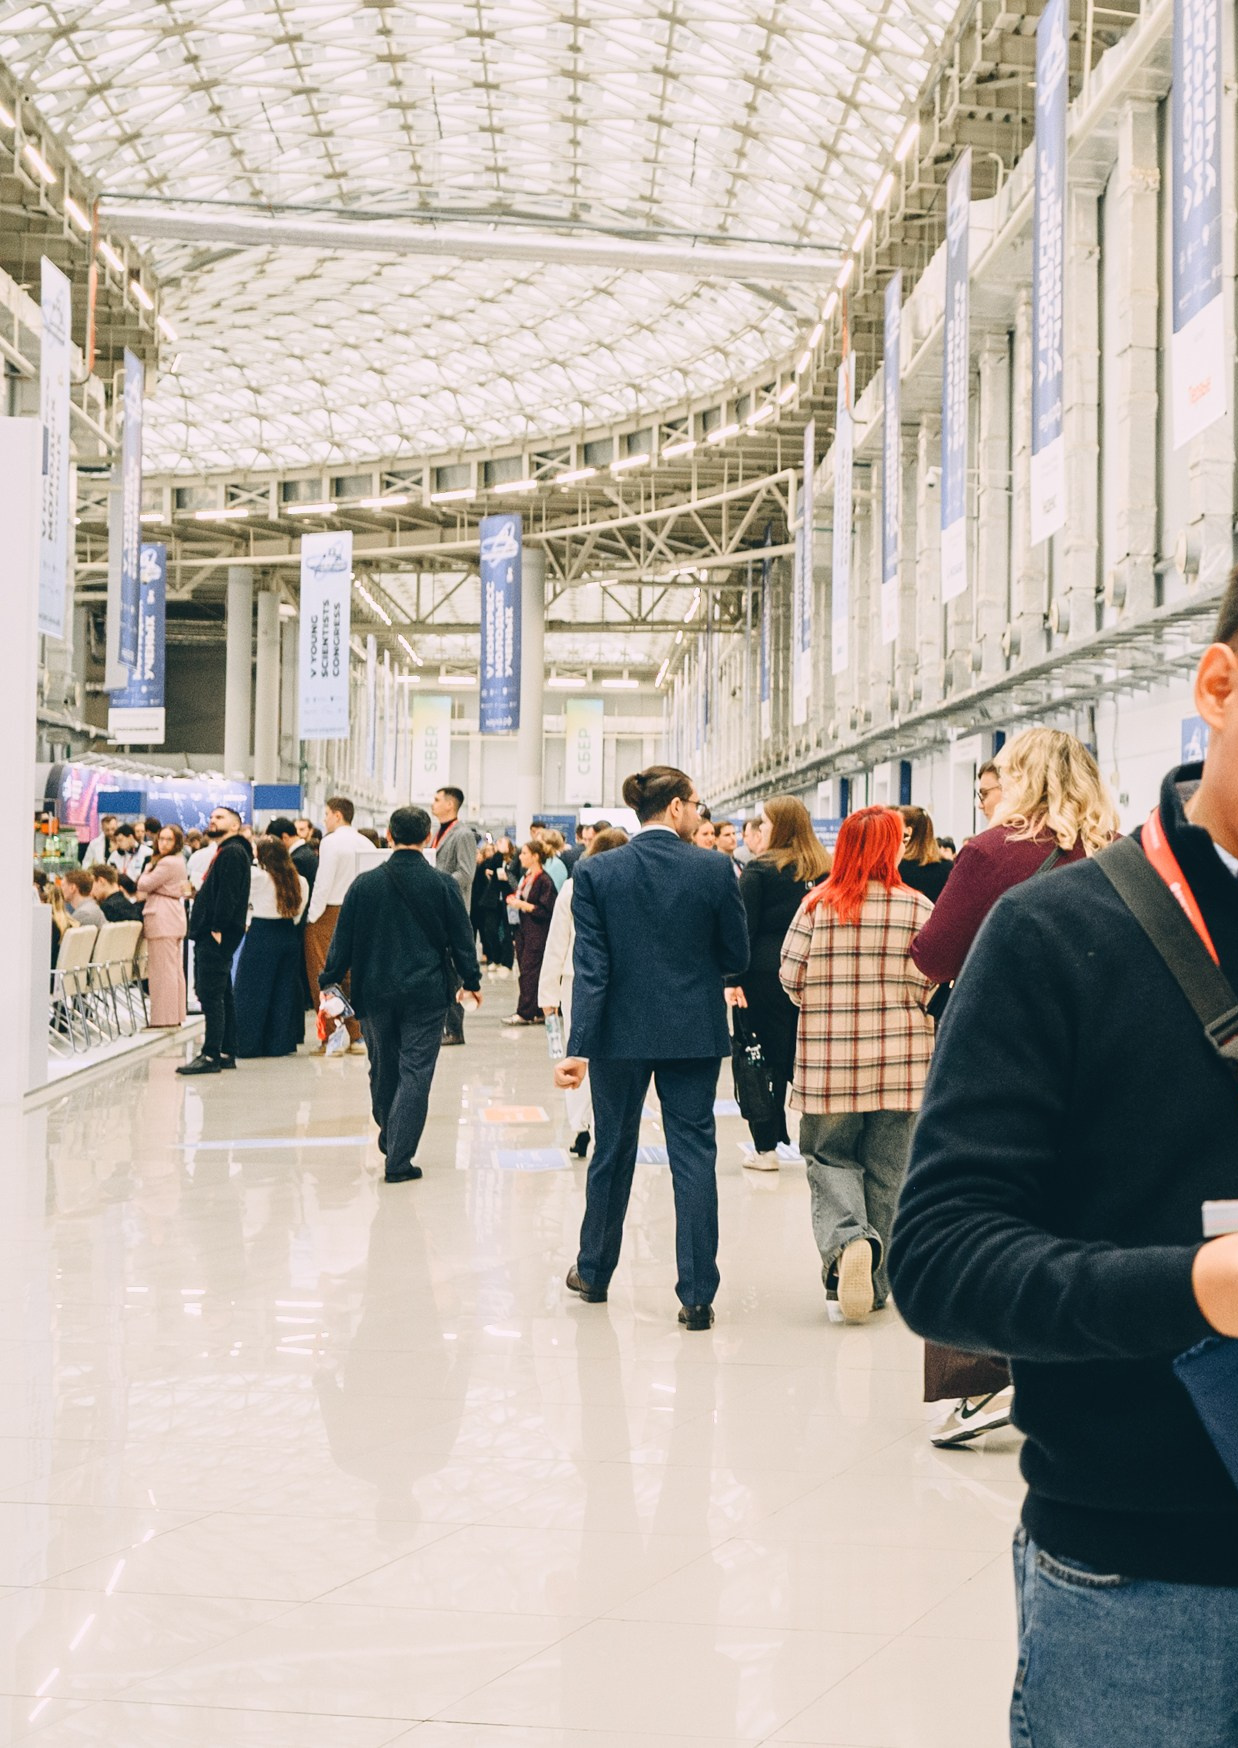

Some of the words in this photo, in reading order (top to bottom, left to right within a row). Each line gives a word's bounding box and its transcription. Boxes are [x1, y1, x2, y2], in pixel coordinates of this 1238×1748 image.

[310, 614, 318, 664] YOUNG
[321, 600, 329, 678] SCIENTISTS
[333, 602, 341, 677] CONGRESS
[425, 726, 438, 772] SBER
[578, 728, 591, 775] СБЕР
